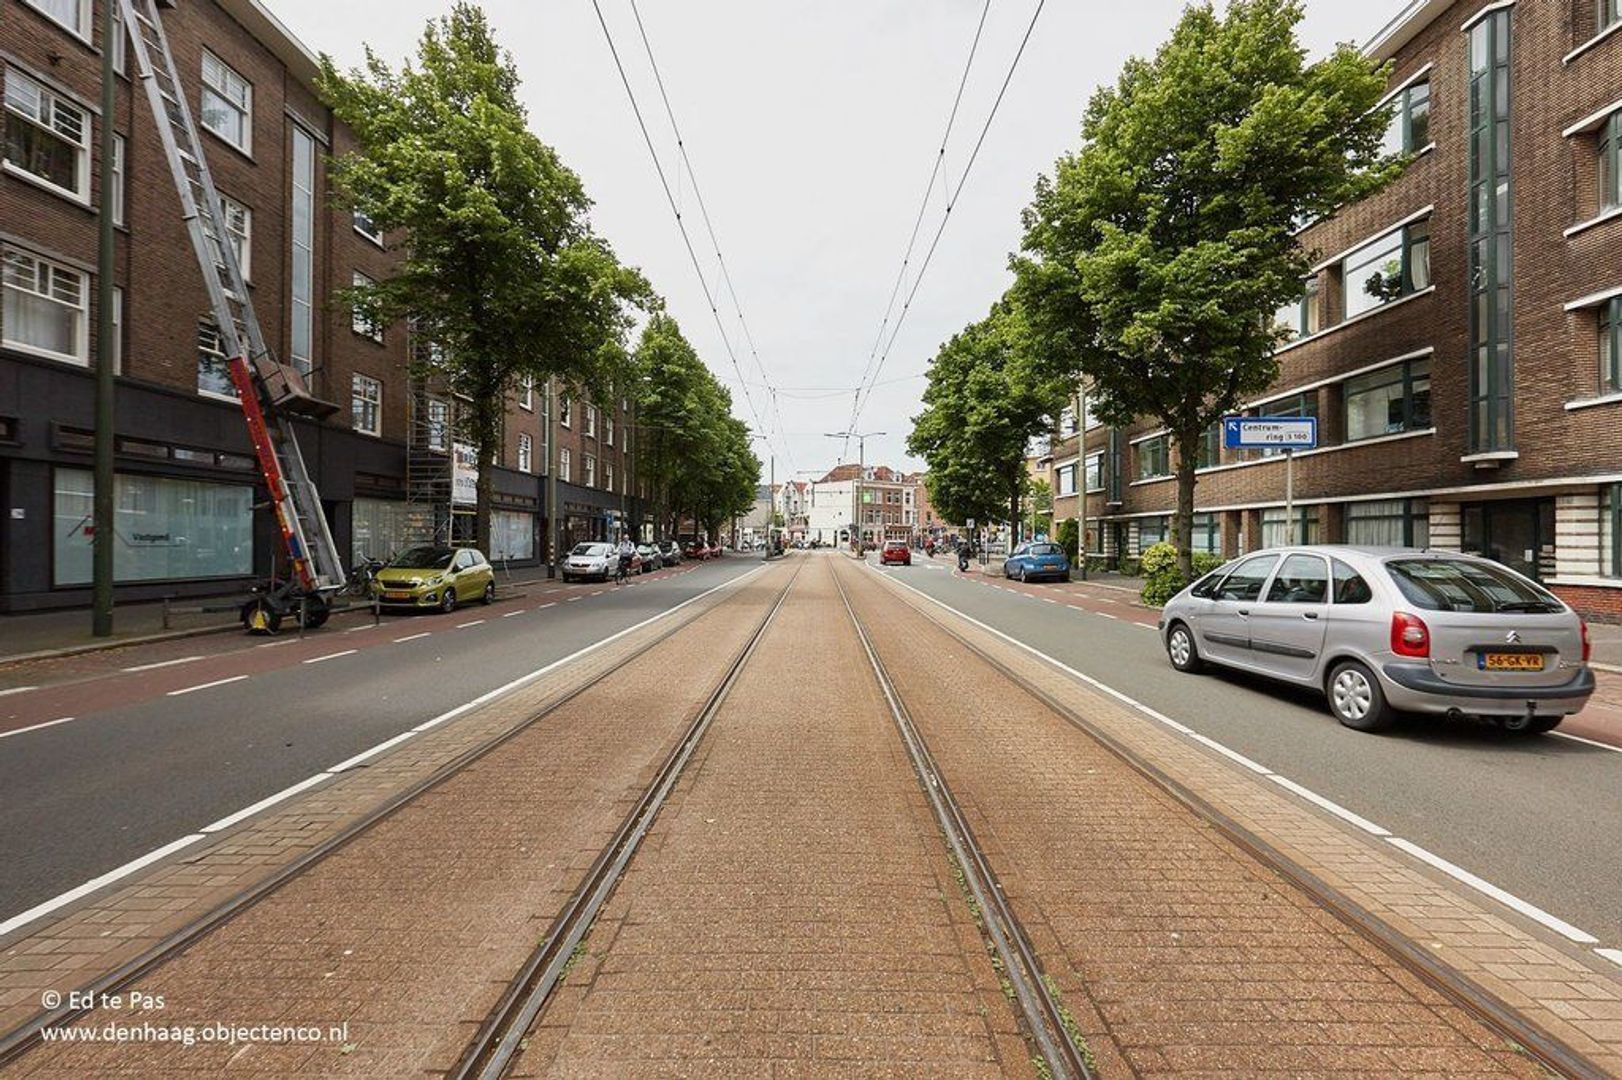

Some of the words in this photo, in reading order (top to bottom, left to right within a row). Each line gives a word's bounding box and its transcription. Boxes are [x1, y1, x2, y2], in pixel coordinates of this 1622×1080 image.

[1265, 433, 1284, 442] ring
[132, 533, 170, 543] Vastgoed
[1488, 655, 1540, 666] 56-GK-VR
